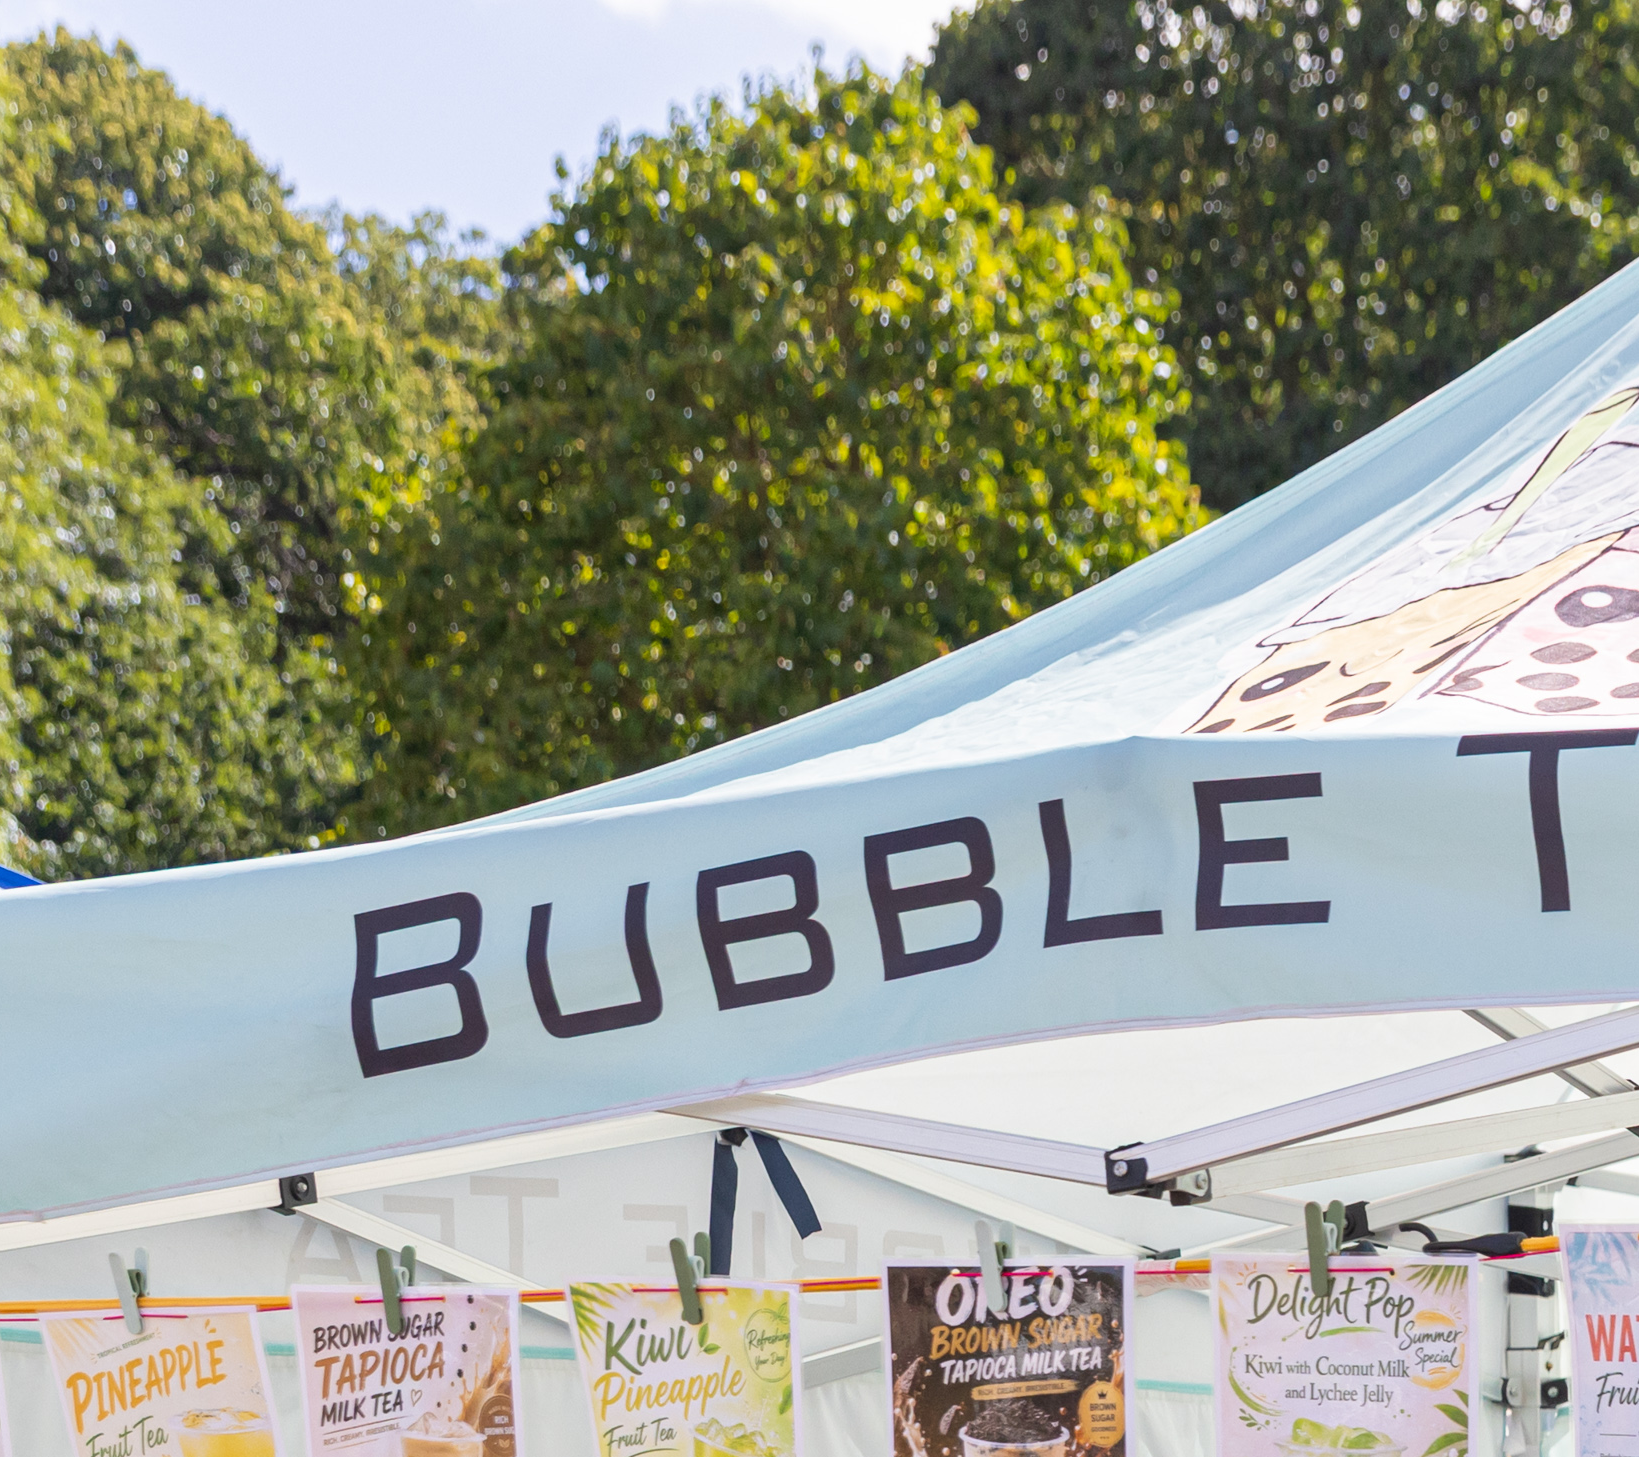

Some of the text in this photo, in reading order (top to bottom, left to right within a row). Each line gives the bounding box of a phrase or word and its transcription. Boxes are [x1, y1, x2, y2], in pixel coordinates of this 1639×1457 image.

[351, 771, 1334, 1078] BUBBLE
[1247, 1274, 1414, 1340] Delight Pop
[313, 1319, 383, 1353] BROWN
[605, 1318, 693, 1375] Kiwi
[929, 1313, 1103, 1360] BROWN SUGAR
[1399, 1321, 1462, 1350] Summer
[315, 1341, 445, 1400] TAPIOCA
[940, 1346, 1101, 1385] TAPIOCA MILK TEA
[1245, 1354, 1410, 1378] Kiwi with Coconut Milk
[1415, 1347, 1460, 1372] Special
[67, 1340, 227, 1435] PINEAPPLE
[594, 1354, 747, 1421] Pineapple
[1285, 1383, 1394, 1408] and Lychee Jelly
[321, 1389, 403, 1427] MILK TEA
[133, 1415, 169, 1455] Tea
[603, 1417, 676, 1457] Fruit Tea
